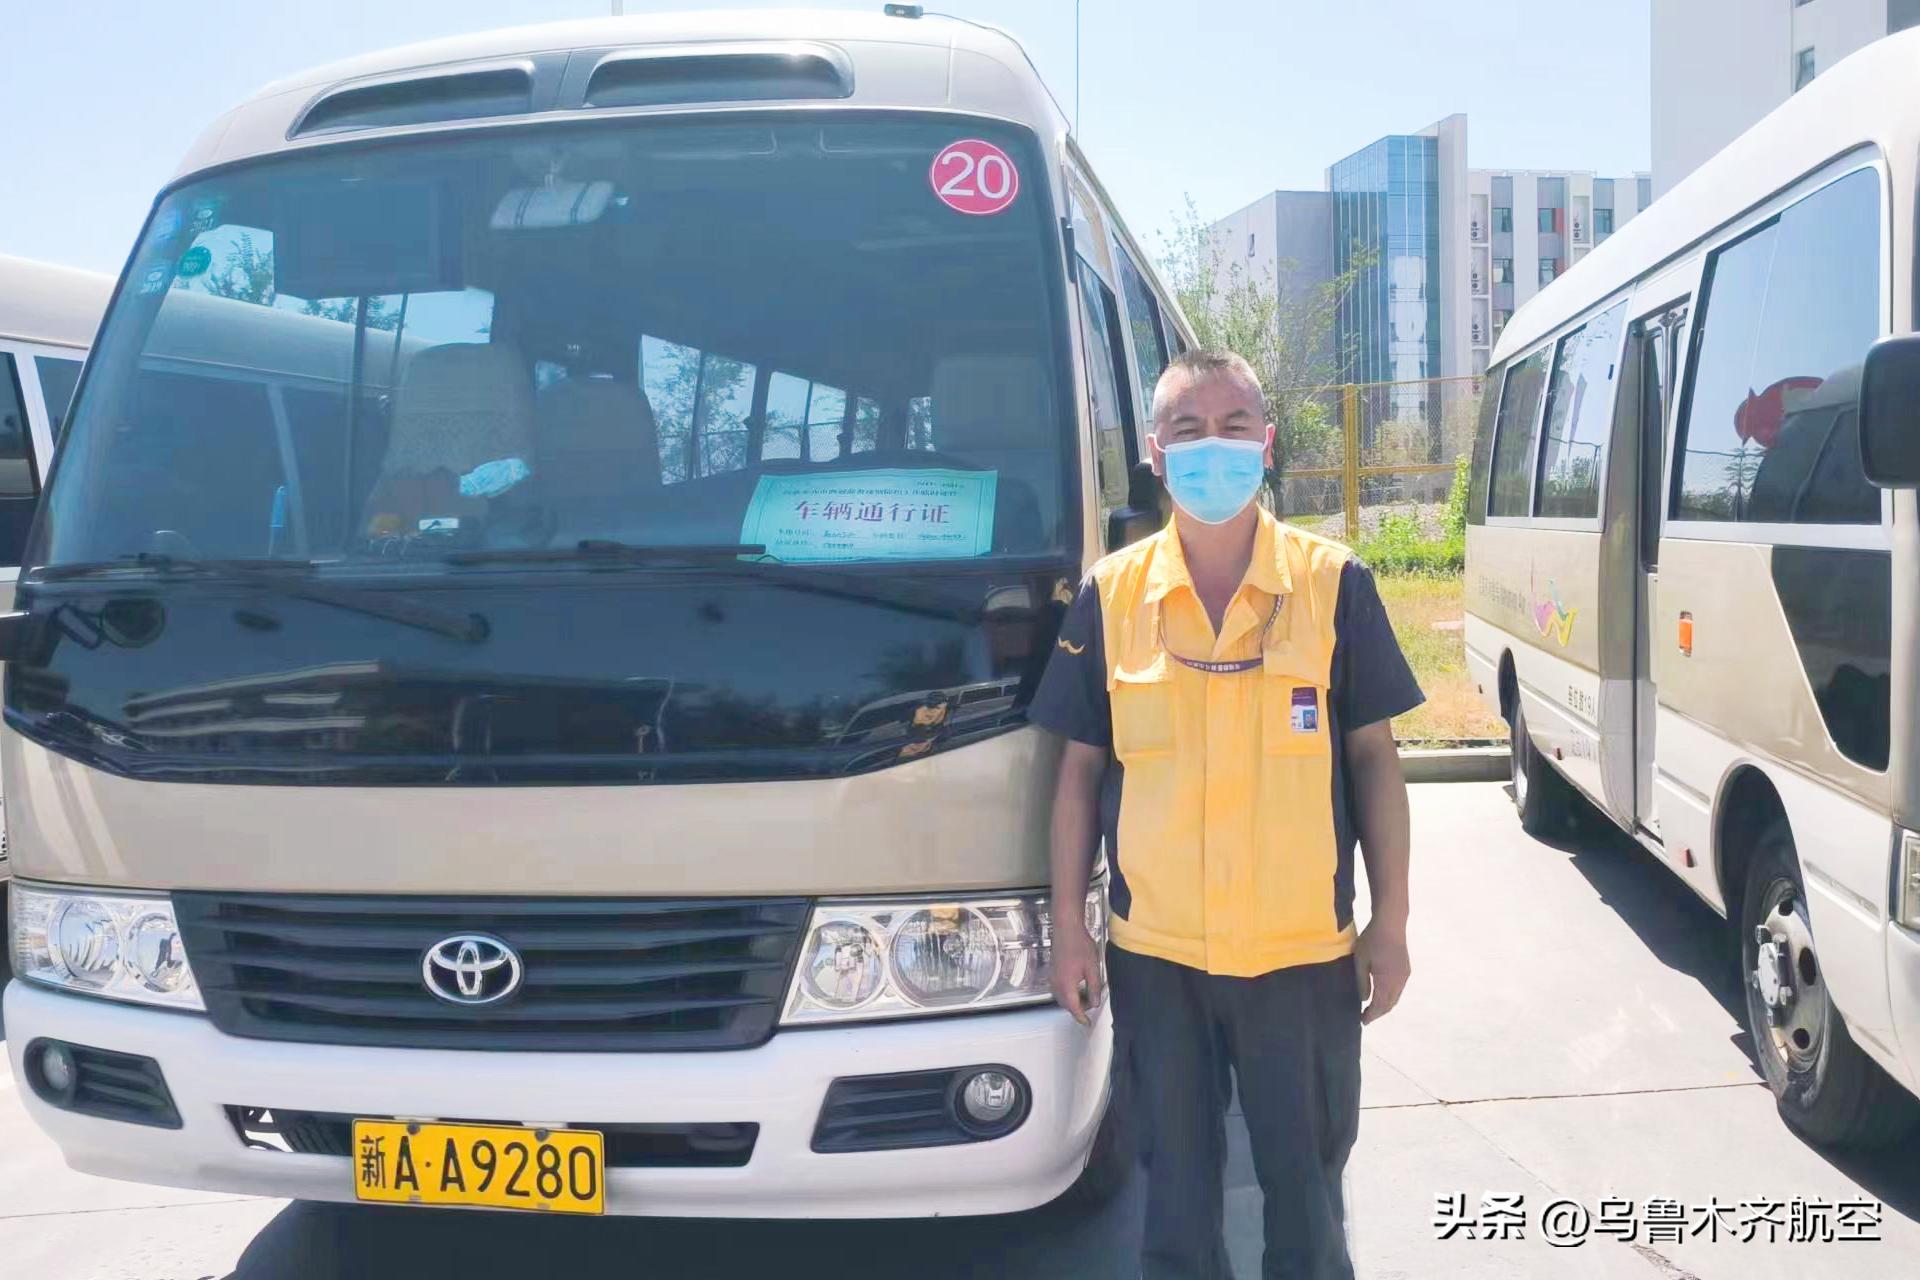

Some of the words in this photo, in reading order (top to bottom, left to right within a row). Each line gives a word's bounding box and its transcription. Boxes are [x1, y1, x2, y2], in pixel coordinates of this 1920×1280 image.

[941, 151, 1010, 199] 20
[795, 500, 950, 524] 车辆通行证
